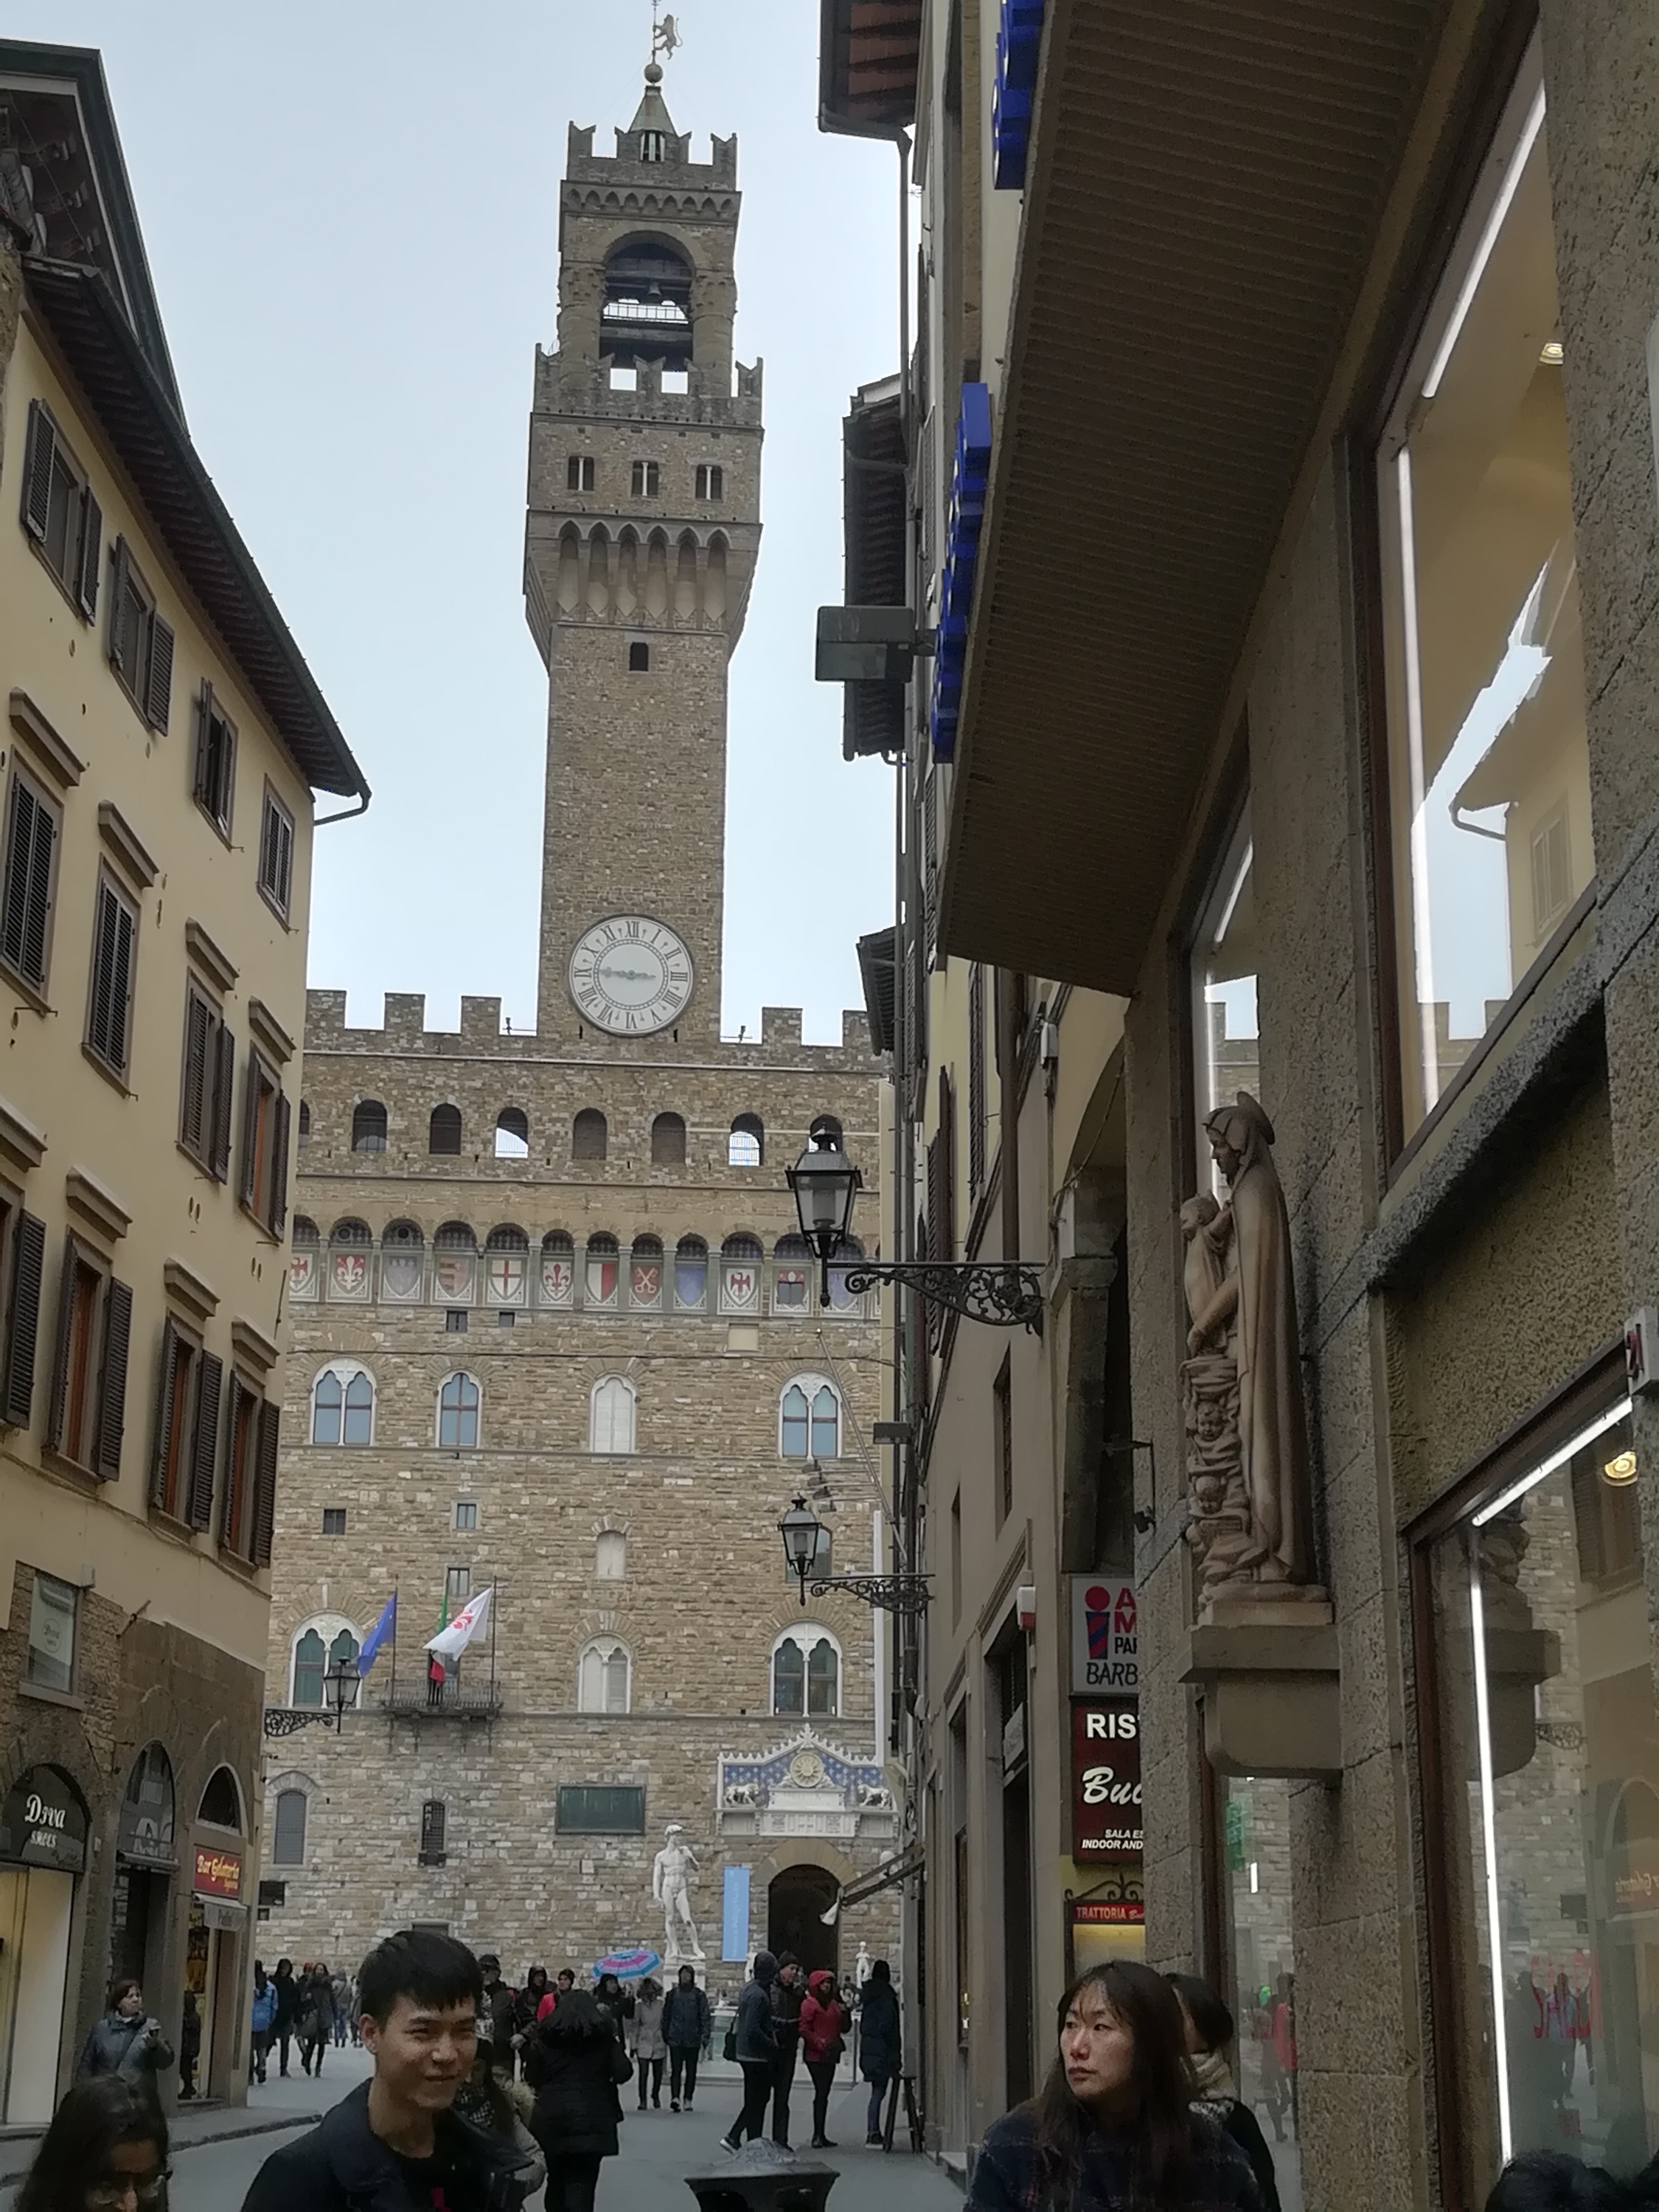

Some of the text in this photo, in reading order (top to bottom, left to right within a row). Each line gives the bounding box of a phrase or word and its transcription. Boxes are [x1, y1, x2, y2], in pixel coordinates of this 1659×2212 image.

[1086, 1662, 1138, 1686] BARB
[1087, 1714, 1140, 1739] RIS
[1105, 1829, 1130, 1839] SALA
[1081, 1839, 1144, 1850] INDOOR AND
[197, 1854, 212, 1874] Bar
[1076, 1907, 1127, 1919] TRATTORIA
